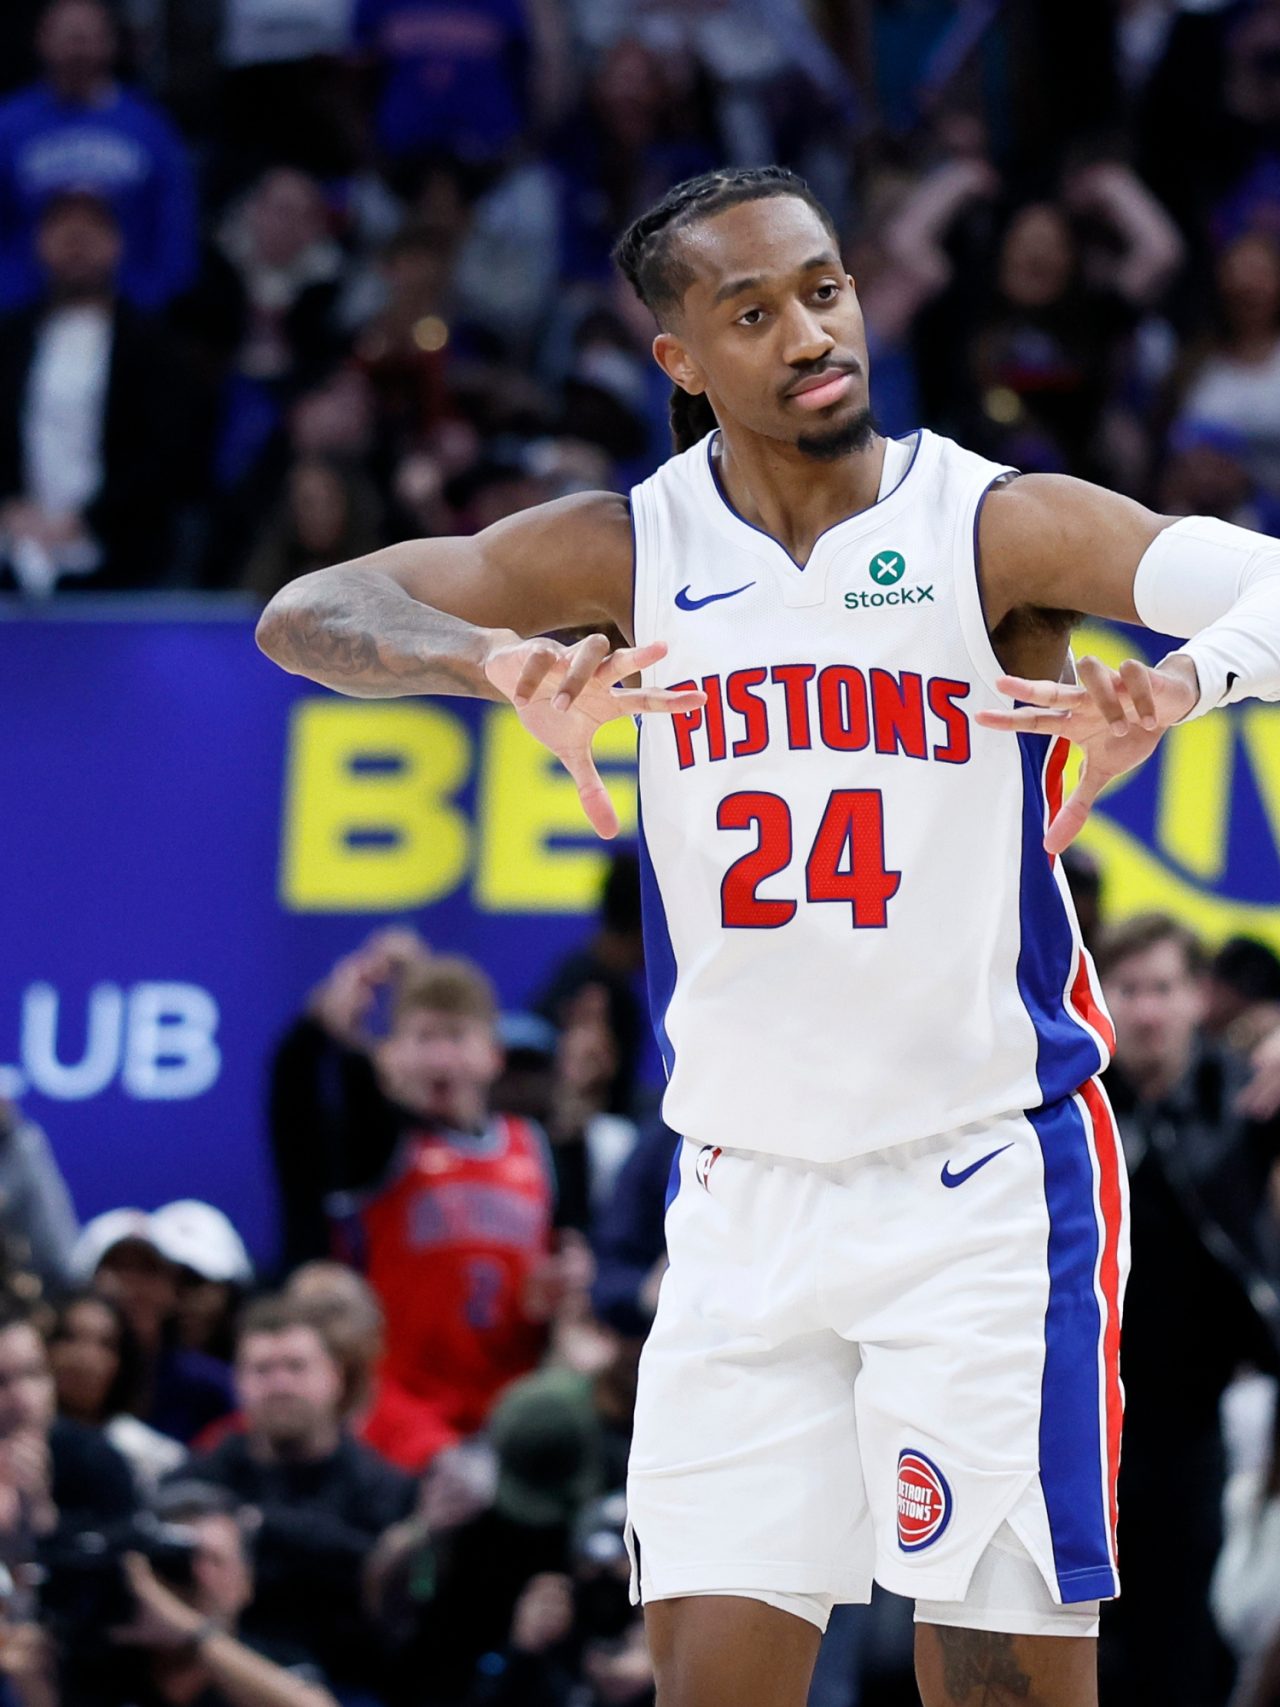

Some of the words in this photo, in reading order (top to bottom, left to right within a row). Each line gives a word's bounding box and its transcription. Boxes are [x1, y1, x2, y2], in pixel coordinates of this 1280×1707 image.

[844, 584, 935, 610] StockX
[665, 663, 971, 771] PISTONS
[716, 788, 902, 929] 24
[0, 980, 222, 1101] UB
